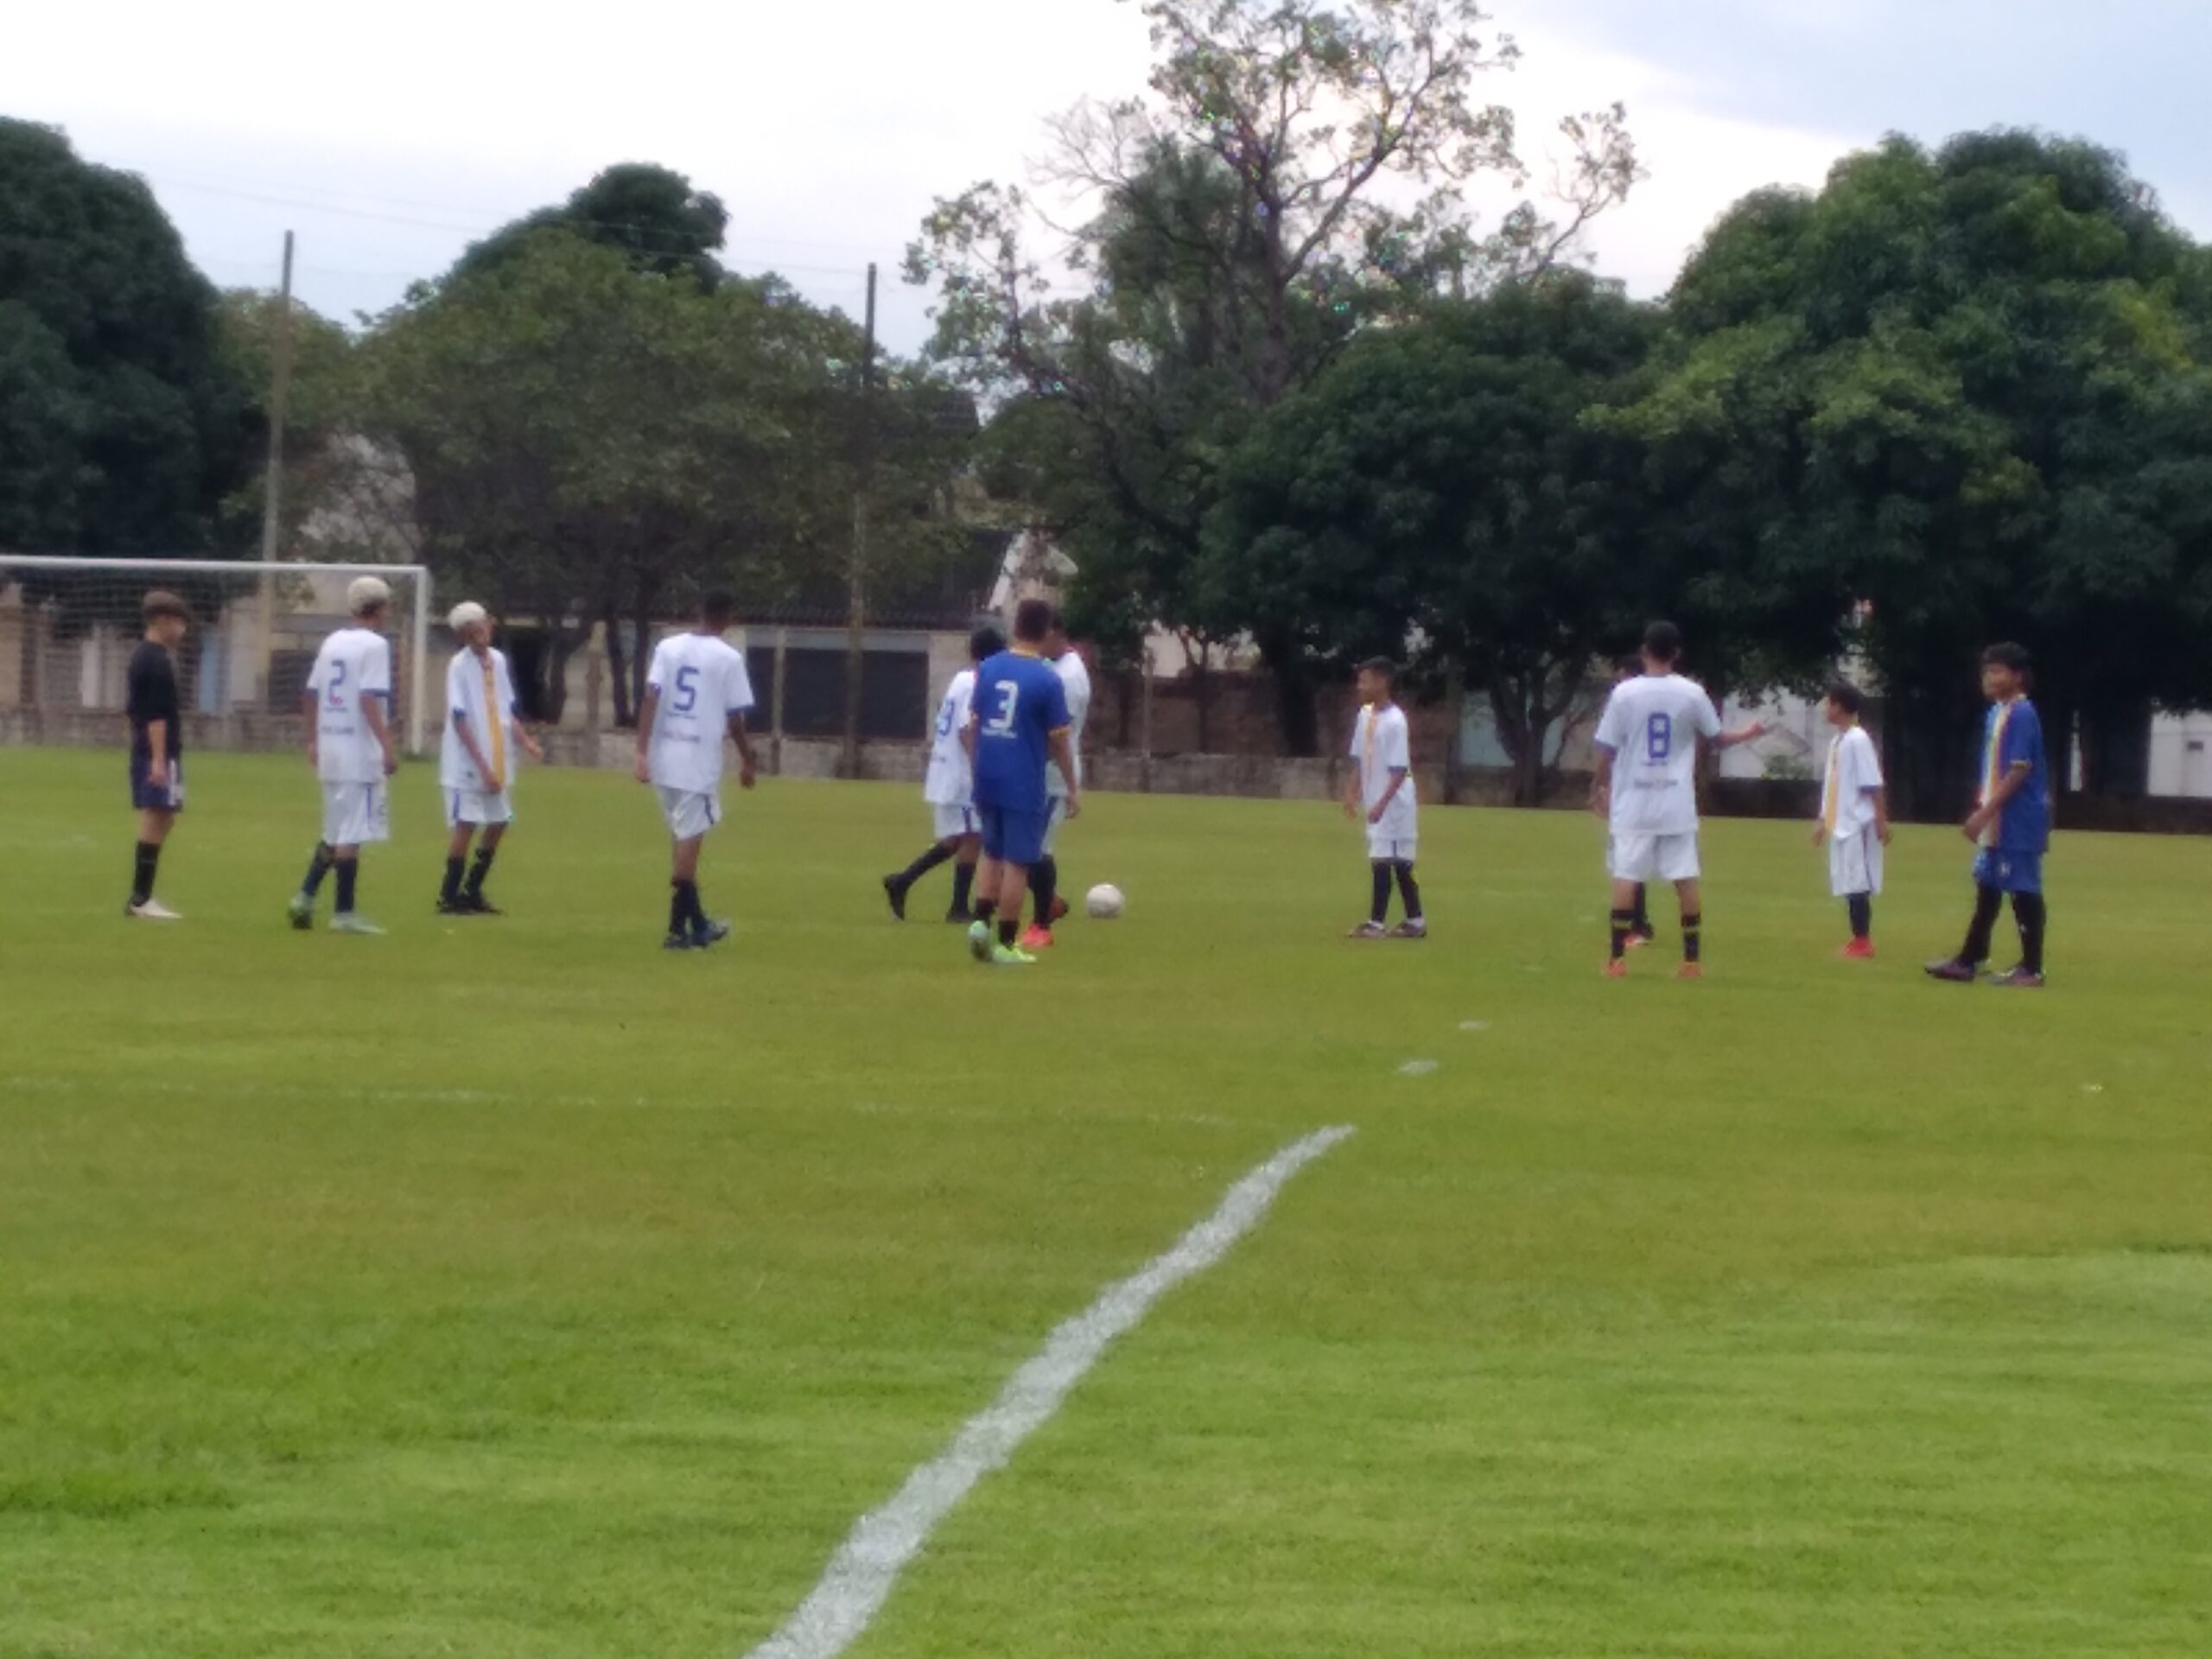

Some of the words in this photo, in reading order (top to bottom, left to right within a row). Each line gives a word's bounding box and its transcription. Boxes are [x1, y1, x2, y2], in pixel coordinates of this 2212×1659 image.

[674, 665, 700, 711] 5
[988, 680, 1018, 728] 3
[1648, 713, 1671, 759] 8
